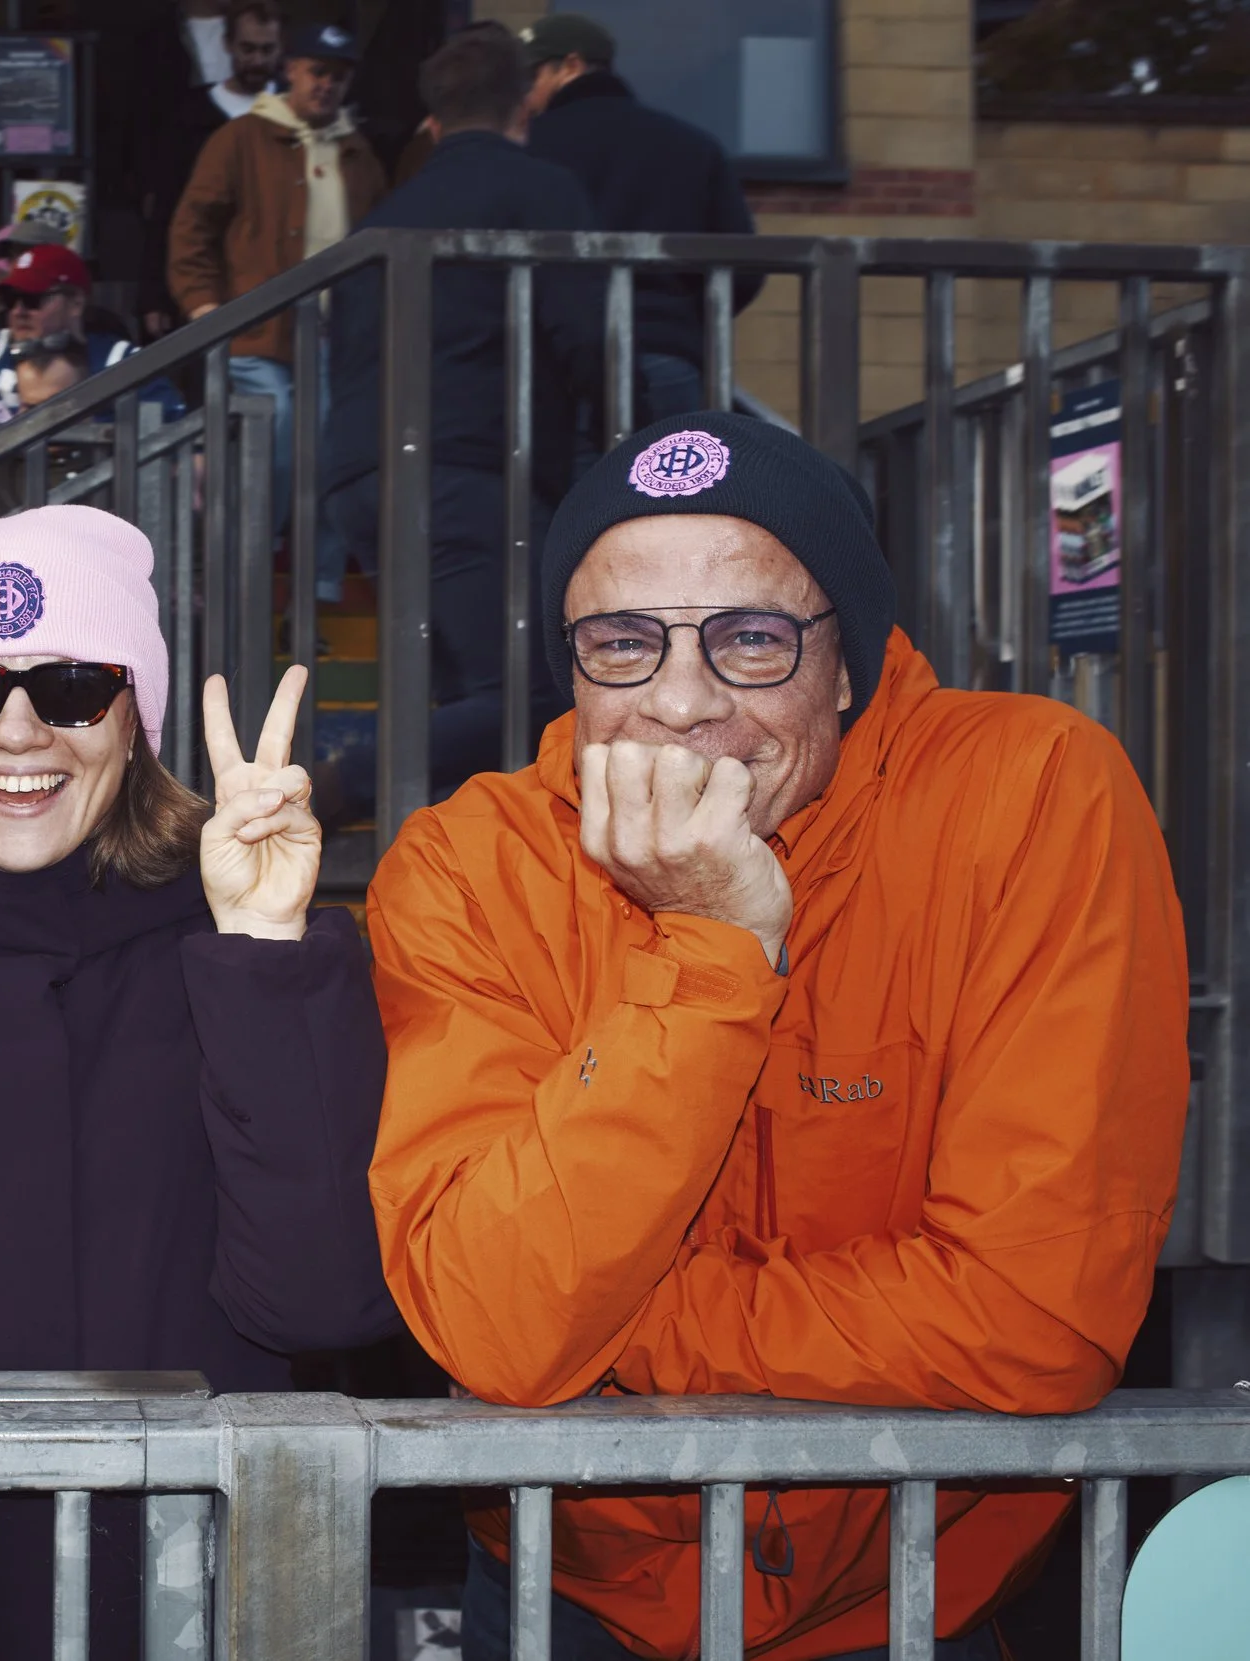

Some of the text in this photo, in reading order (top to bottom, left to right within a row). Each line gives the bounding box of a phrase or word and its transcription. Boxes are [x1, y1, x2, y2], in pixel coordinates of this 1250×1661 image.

[642, 473, 687, 490] FOUNDED
[0, 569, 32, 586] HAMLET
[27, 587, 38, 599] FC
[16, 608, 35, 628] 1893
[818, 1073, 884, 1104] Rab
